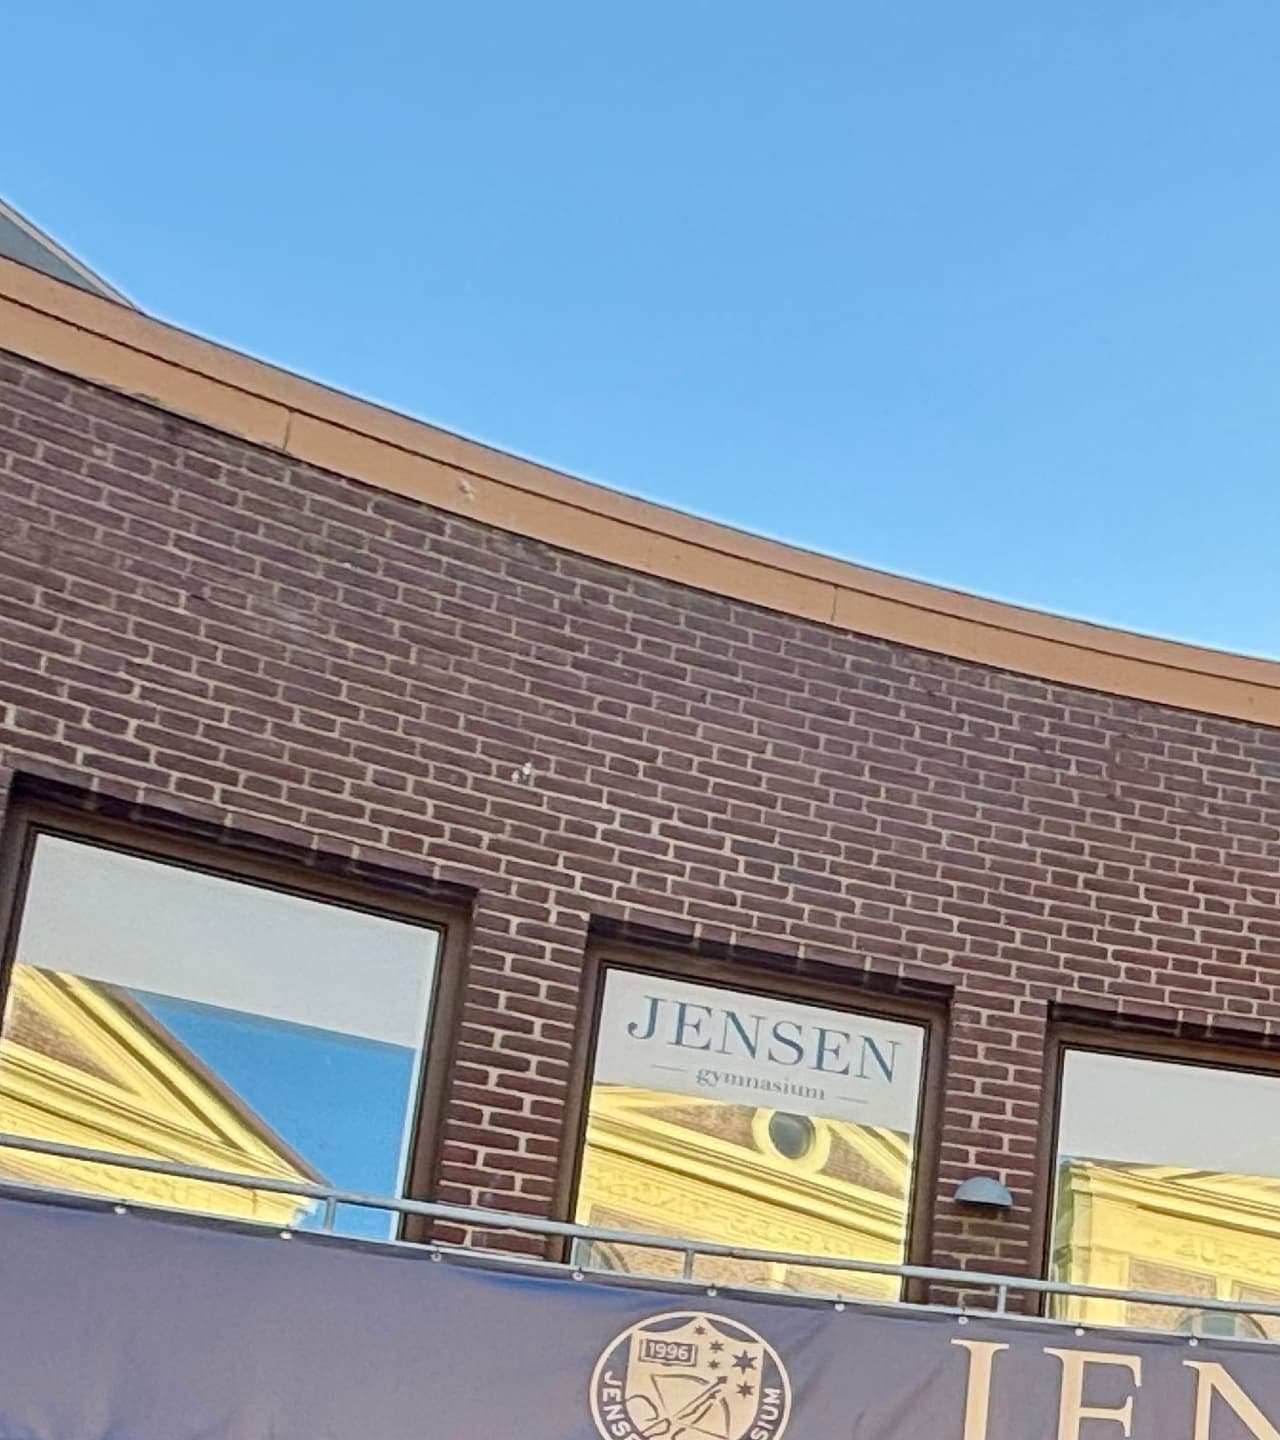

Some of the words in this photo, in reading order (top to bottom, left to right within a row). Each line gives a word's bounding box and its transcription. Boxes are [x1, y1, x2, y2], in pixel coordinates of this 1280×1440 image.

[626, 995, 903, 1083] JENSEN
[695, 1067, 826, 1101] gymnasium
[649, 1342, 690, 1360] 1996
